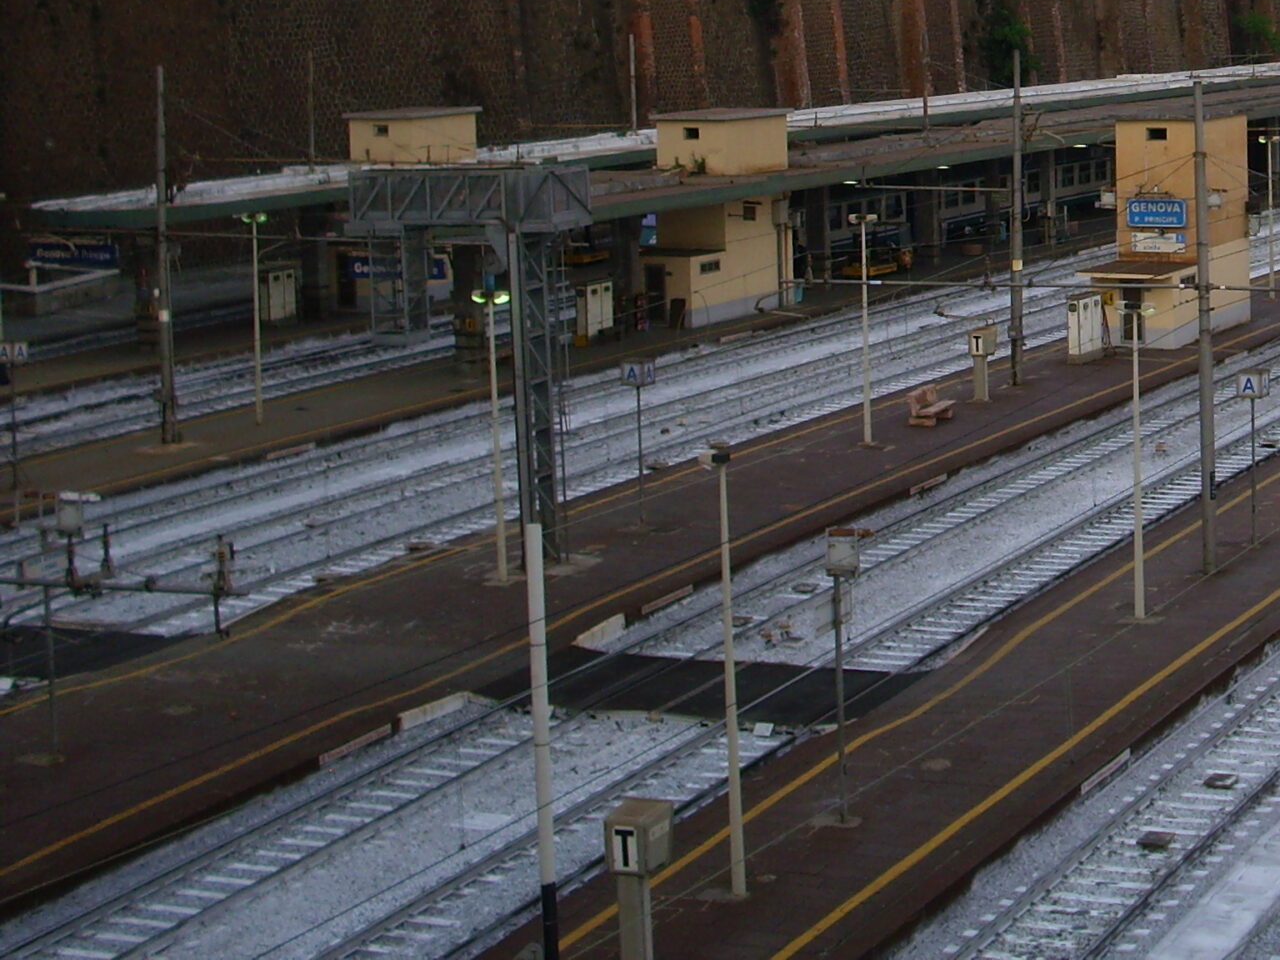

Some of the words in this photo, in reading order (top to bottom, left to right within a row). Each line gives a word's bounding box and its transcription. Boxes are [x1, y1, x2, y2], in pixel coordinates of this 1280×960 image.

[1131, 202, 1181, 213] GENOVA
[1144, 216, 1178, 224] PRINCIPE
[972, 336, 981, 352] T
[627, 366, 637, 381] A
[1242, 377, 1256, 393] A
[614, 829, 635, 867] T
